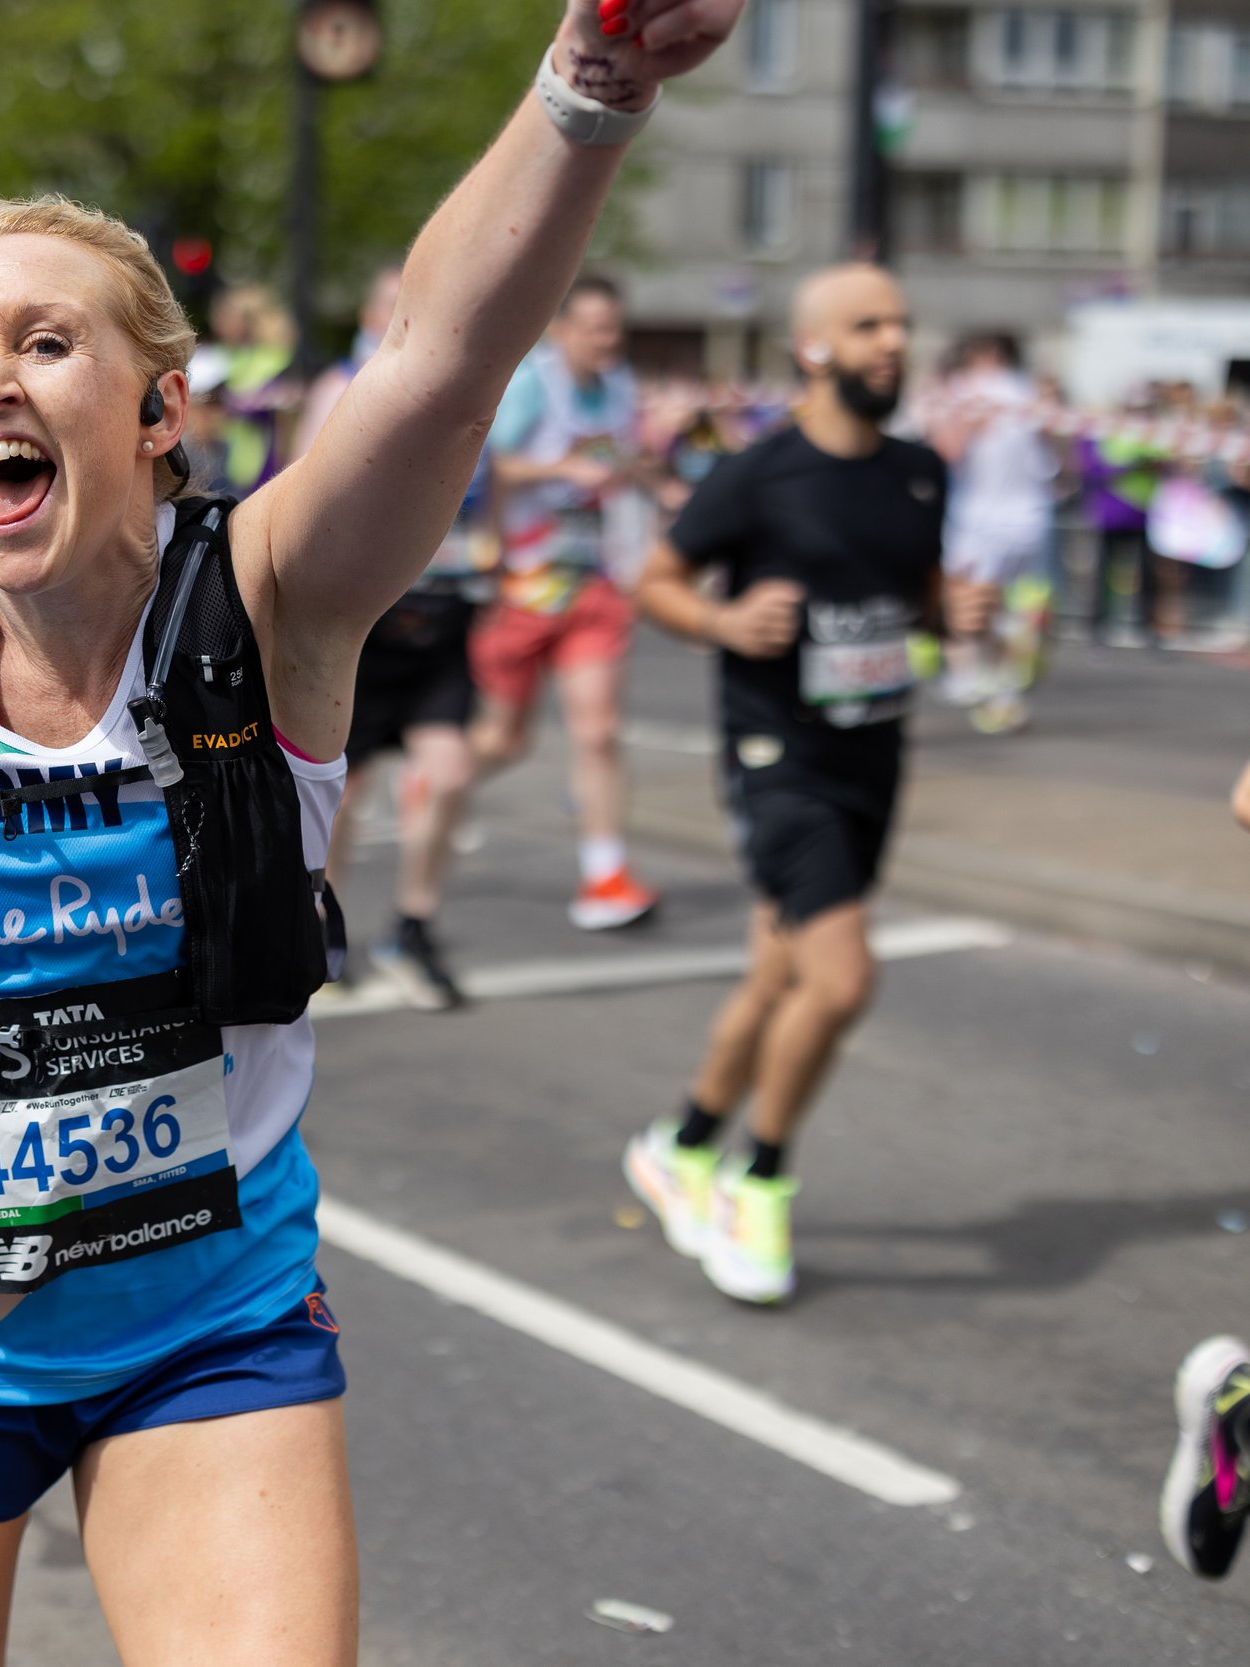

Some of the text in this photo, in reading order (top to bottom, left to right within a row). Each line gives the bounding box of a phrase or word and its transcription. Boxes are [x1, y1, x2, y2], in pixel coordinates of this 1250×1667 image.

[192, 721, 258, 749] EVADICT
[50, 873, 185, 956] Ryde
[33, 1003, 105, 1027] TATA
[46, 1043, 145, 1076] SERVICES
[26, 1093, 99, 1110] #WeRunTogether
[158, 1166, 187, 1180] FITTED
[54, 1208, 212, 1267] new balance
